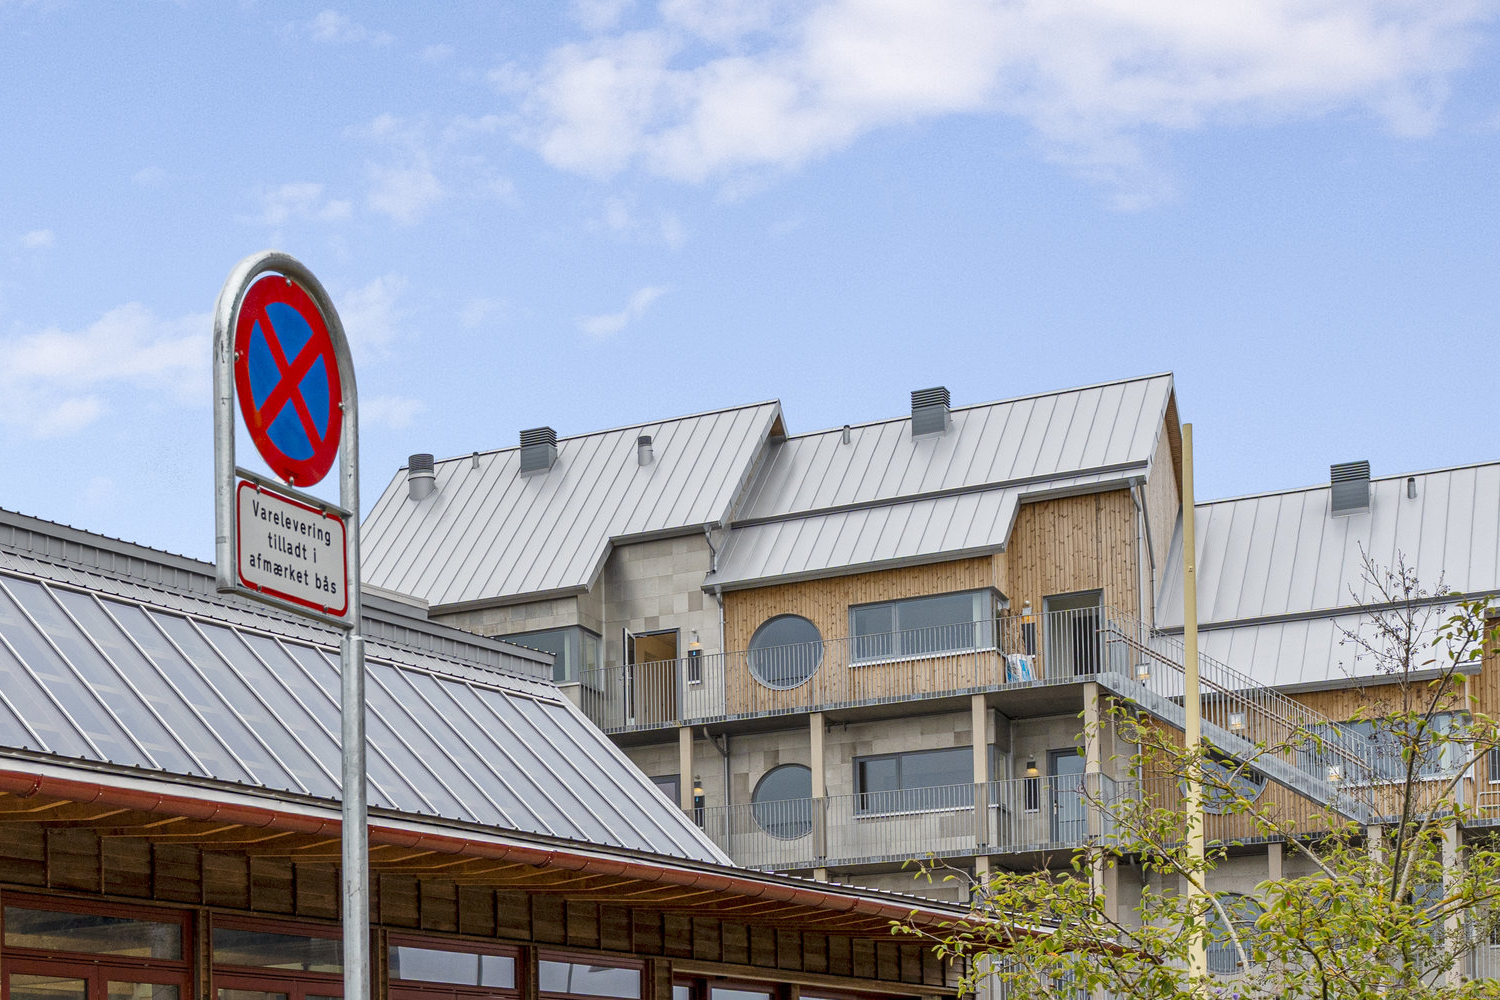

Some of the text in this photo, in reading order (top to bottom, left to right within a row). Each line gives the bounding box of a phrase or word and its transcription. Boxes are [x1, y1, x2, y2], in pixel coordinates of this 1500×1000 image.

[252, 499, 332, 546] Varelevering
[267, 532, 317, 563] tilladt i
[249, 553, 309, 586] afmærket
[315, 573, 337, 594] bås
